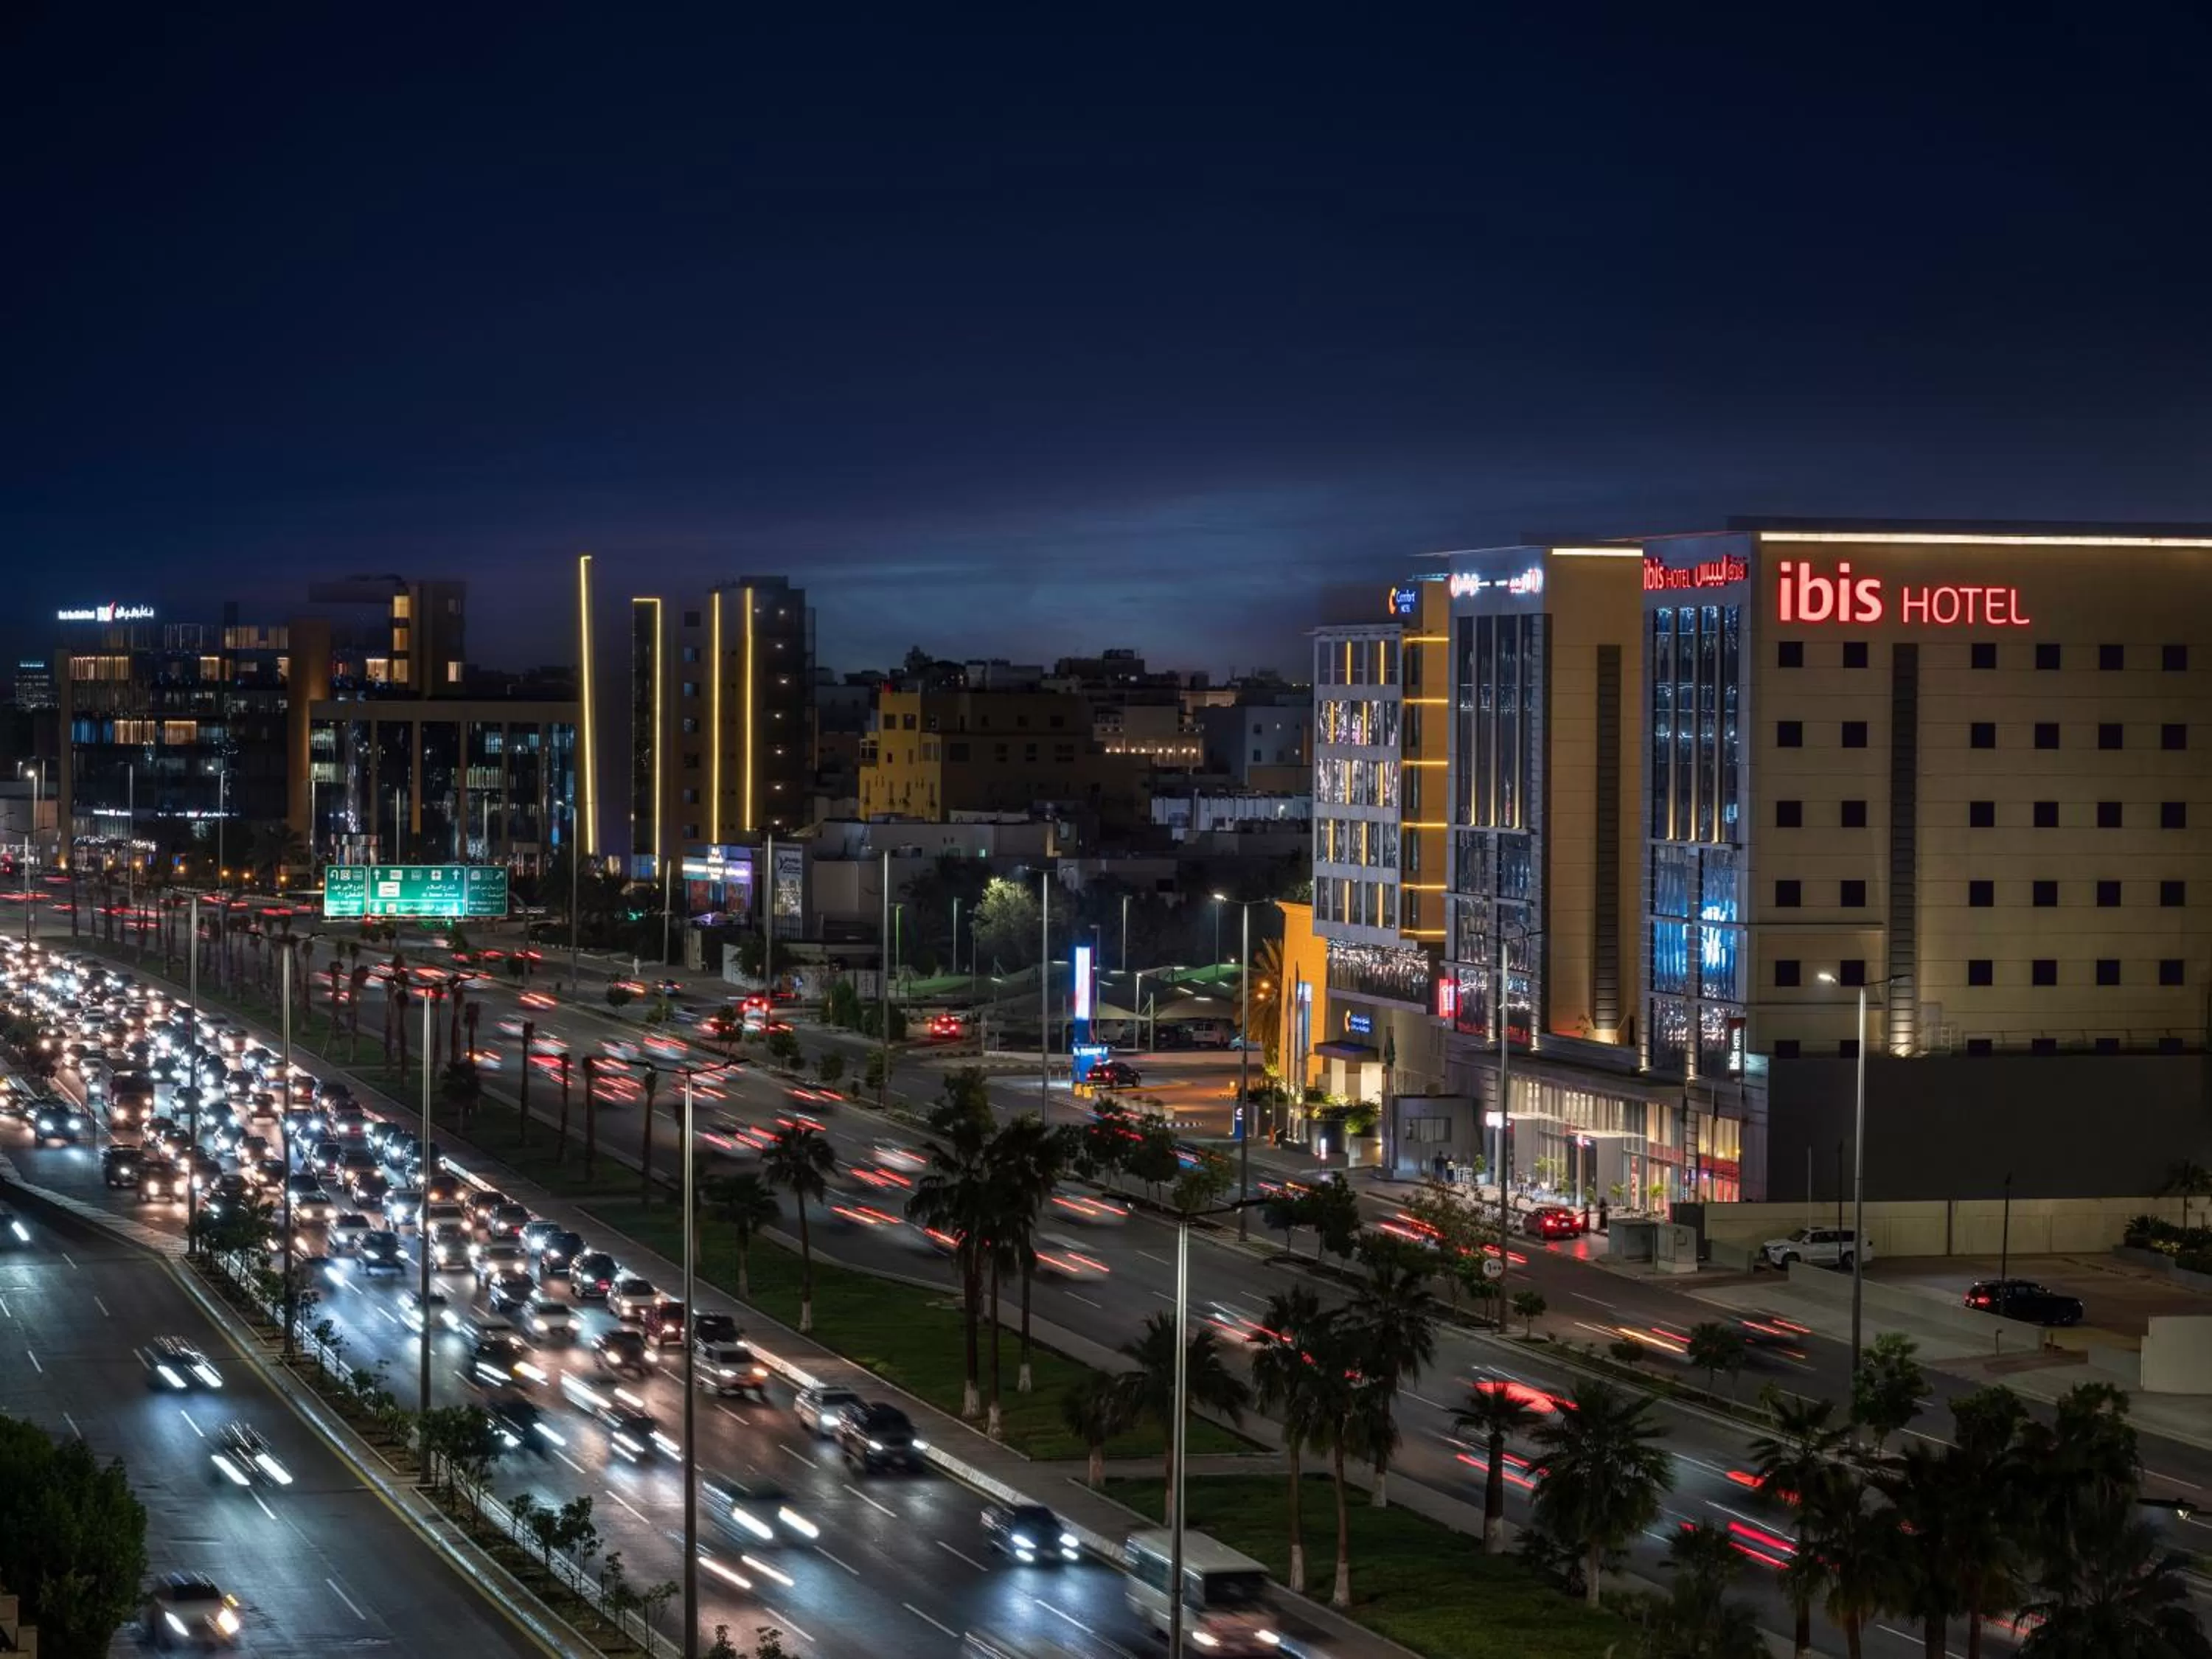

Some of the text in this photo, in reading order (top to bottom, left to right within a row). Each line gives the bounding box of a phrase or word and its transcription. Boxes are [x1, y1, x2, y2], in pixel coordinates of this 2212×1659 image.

[1644, 558, 1691, 589] ibis HOTEL
[1779, 561, 2030, 625] ibis HOTEL
